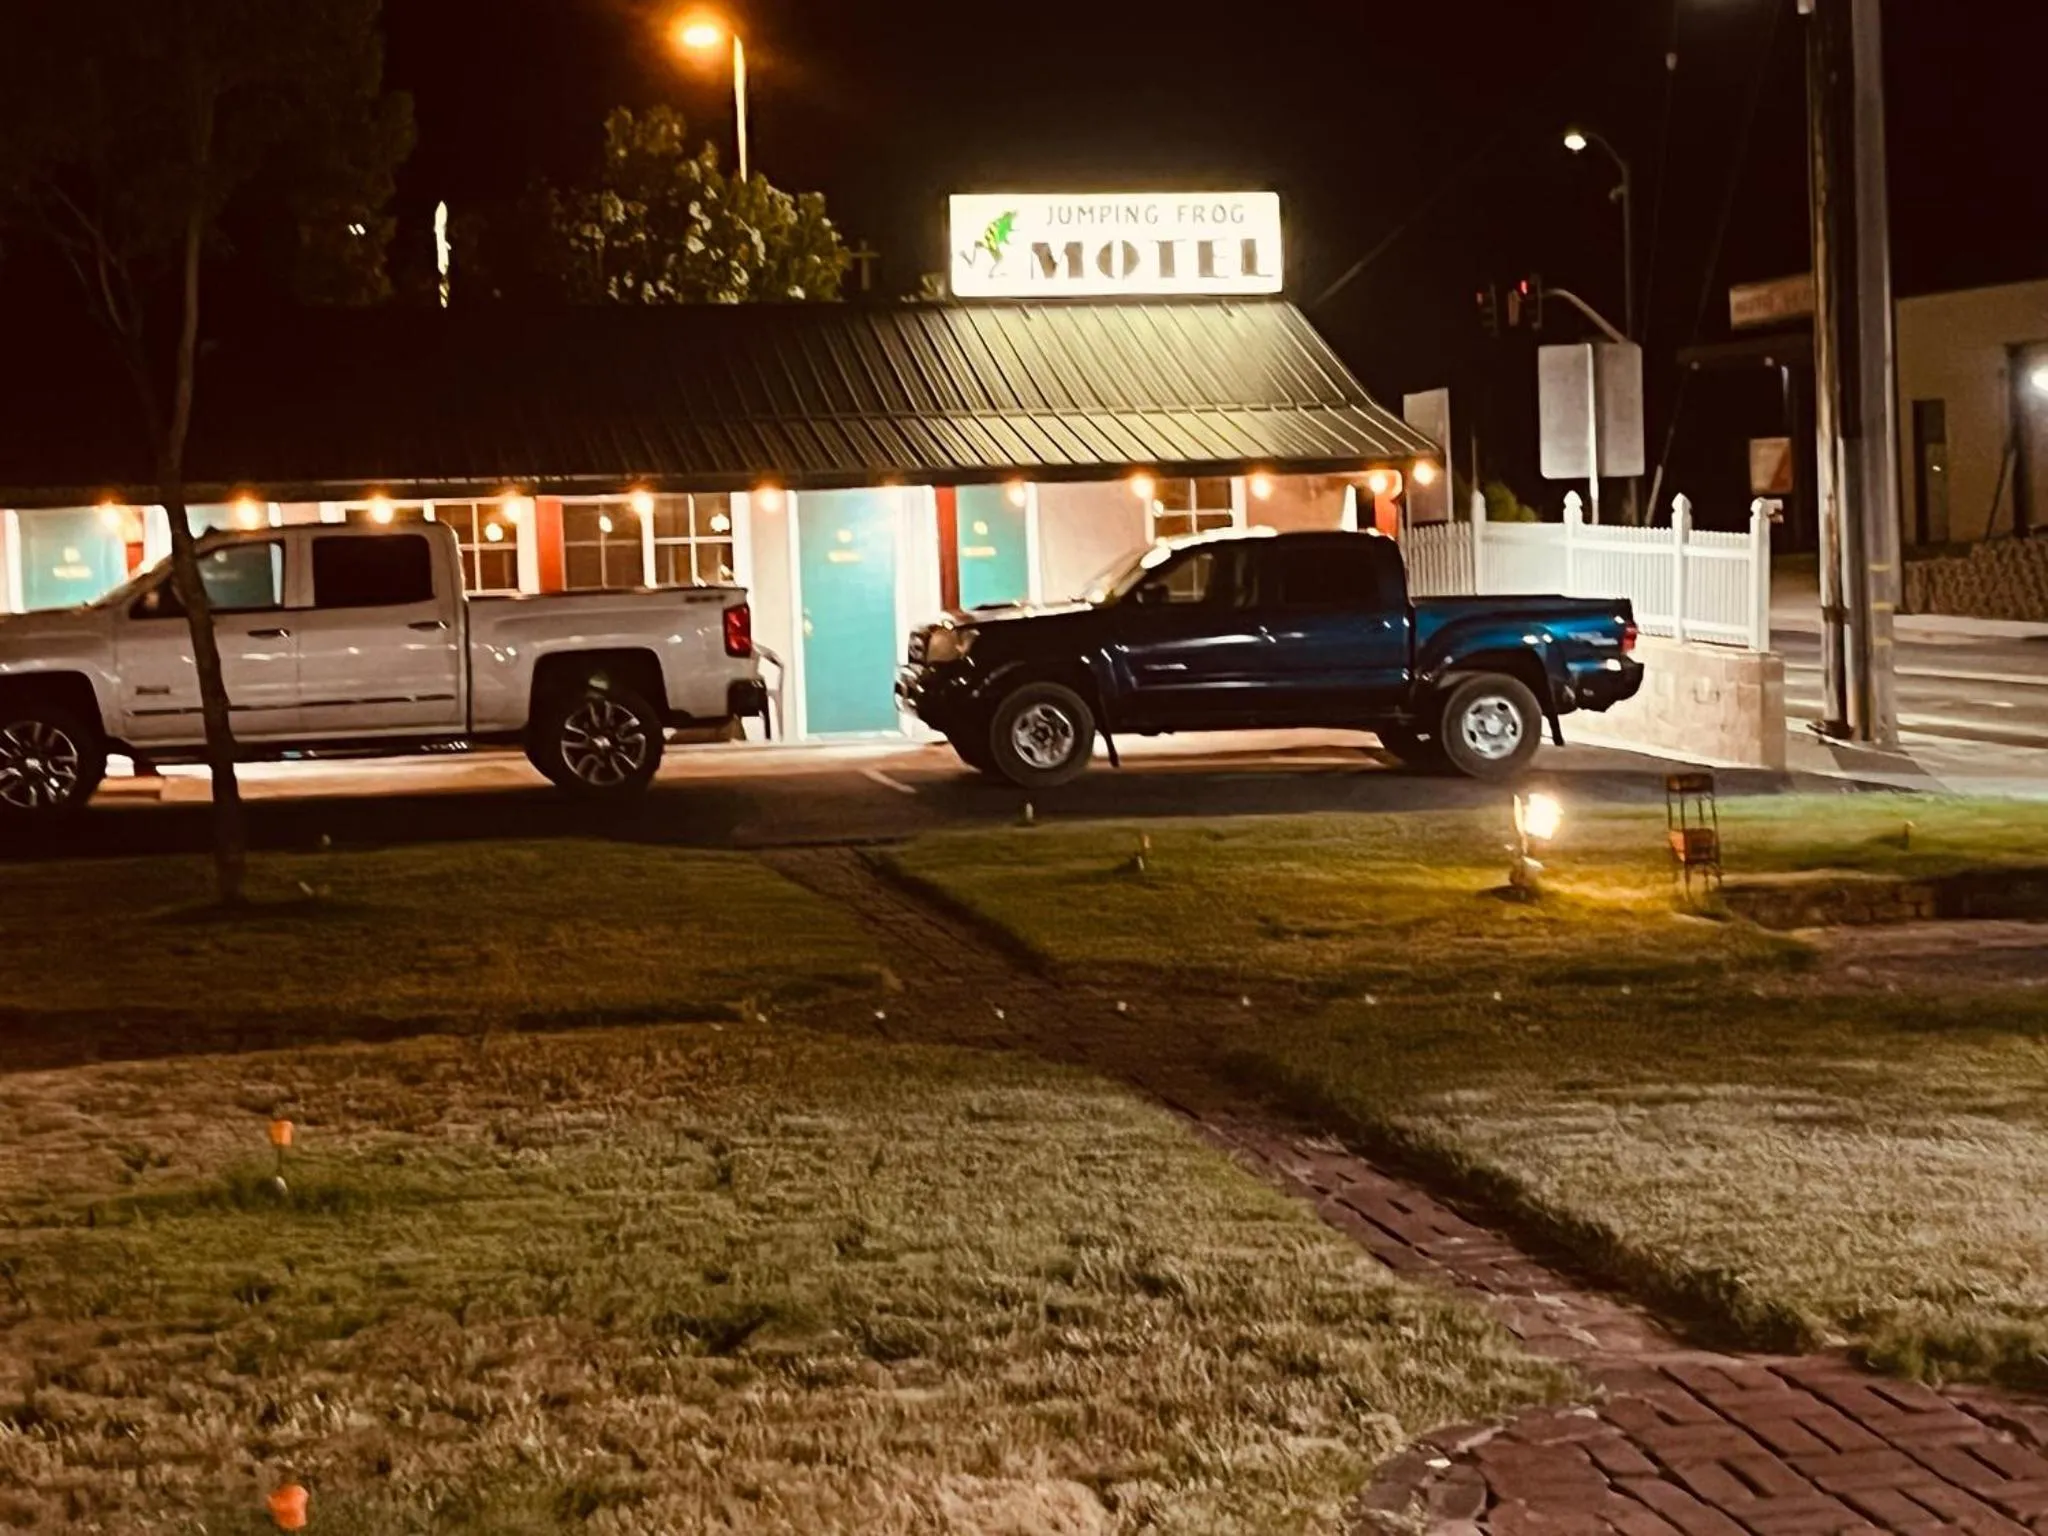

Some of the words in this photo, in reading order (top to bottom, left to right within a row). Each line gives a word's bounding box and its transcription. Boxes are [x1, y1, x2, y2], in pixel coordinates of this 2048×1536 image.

[1046, 204, 1159, 225] JUMPING
[1177, 204, 1245, 225] FROG
[1031, 238, 1274, 280] MOTEL
